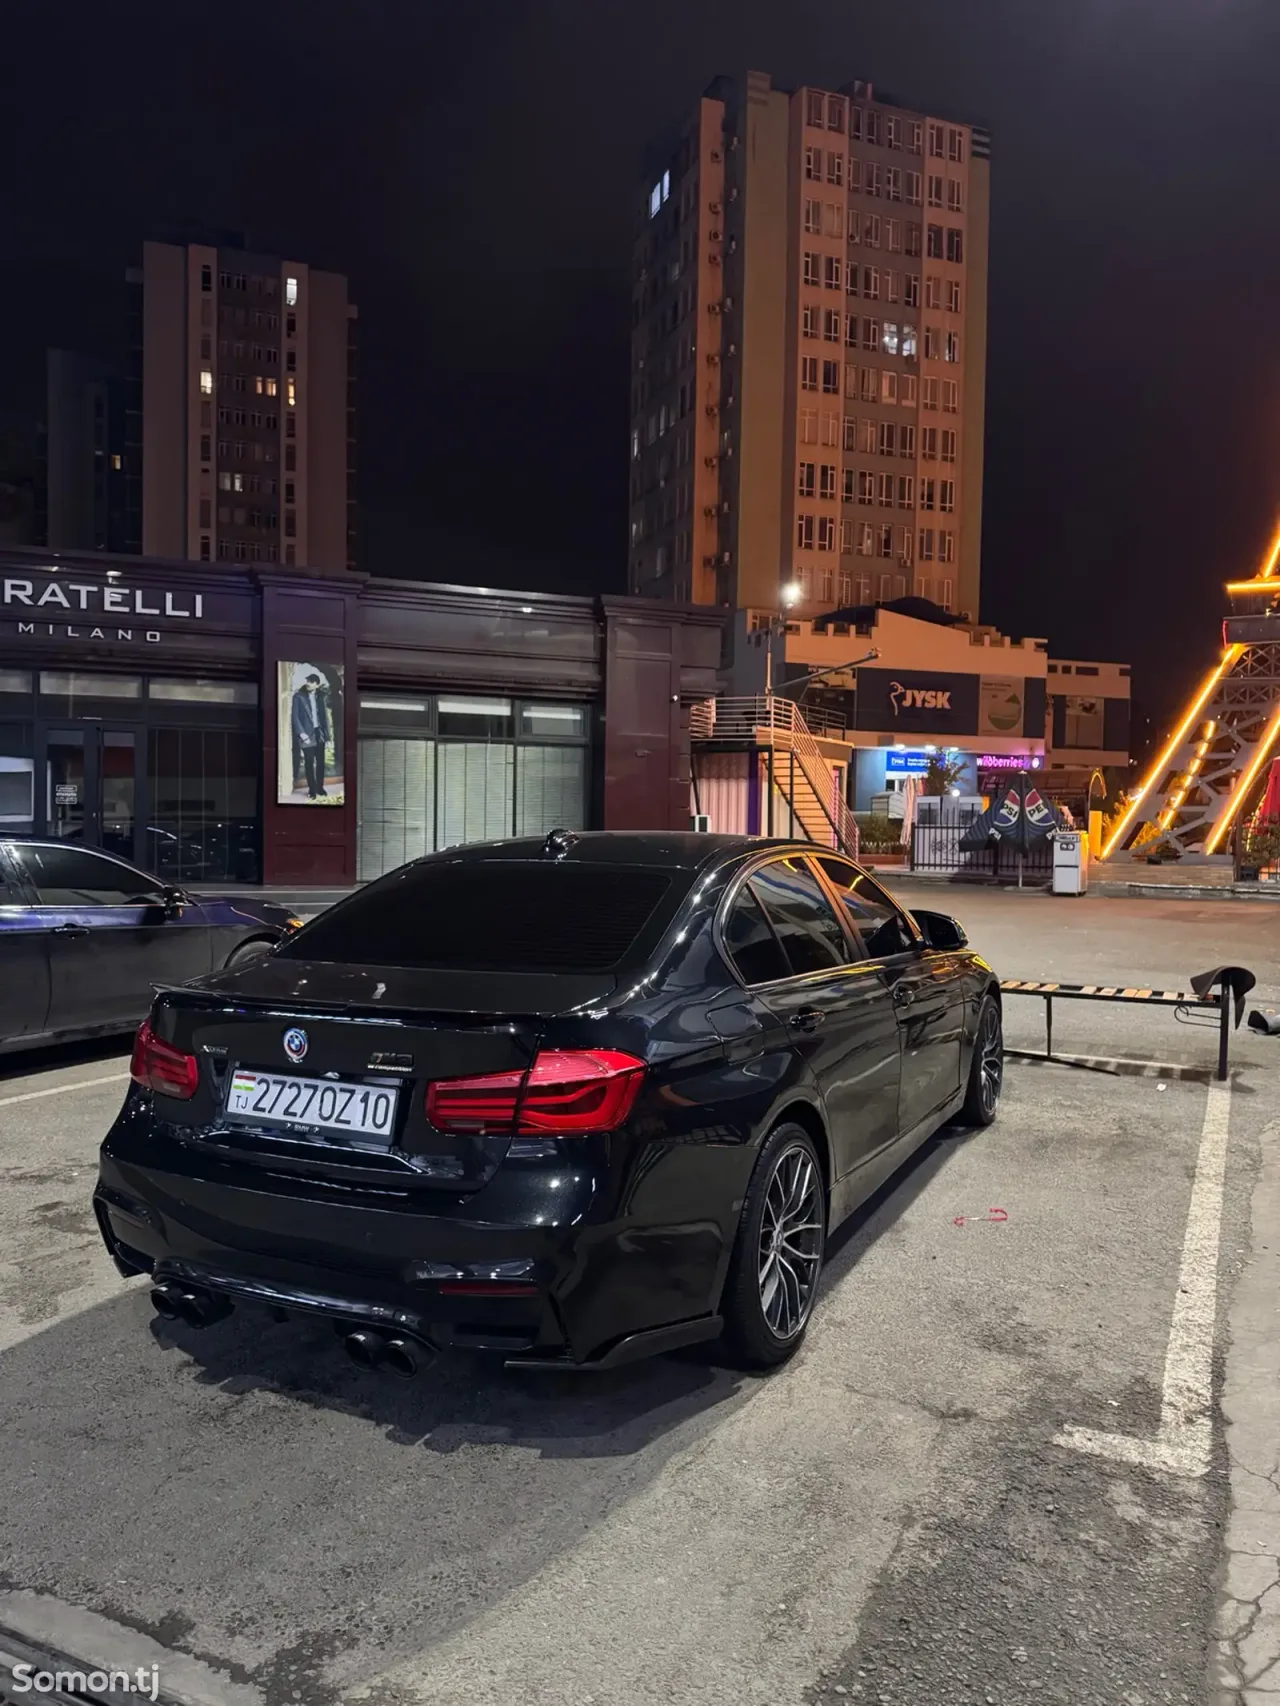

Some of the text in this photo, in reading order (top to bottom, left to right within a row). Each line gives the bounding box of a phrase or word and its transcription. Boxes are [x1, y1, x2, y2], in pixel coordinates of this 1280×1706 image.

[18, 622, 161, 642] MILANO
[902, 688, 951, 709] JYSK
[235, 1094, 249, 1110] TJ
